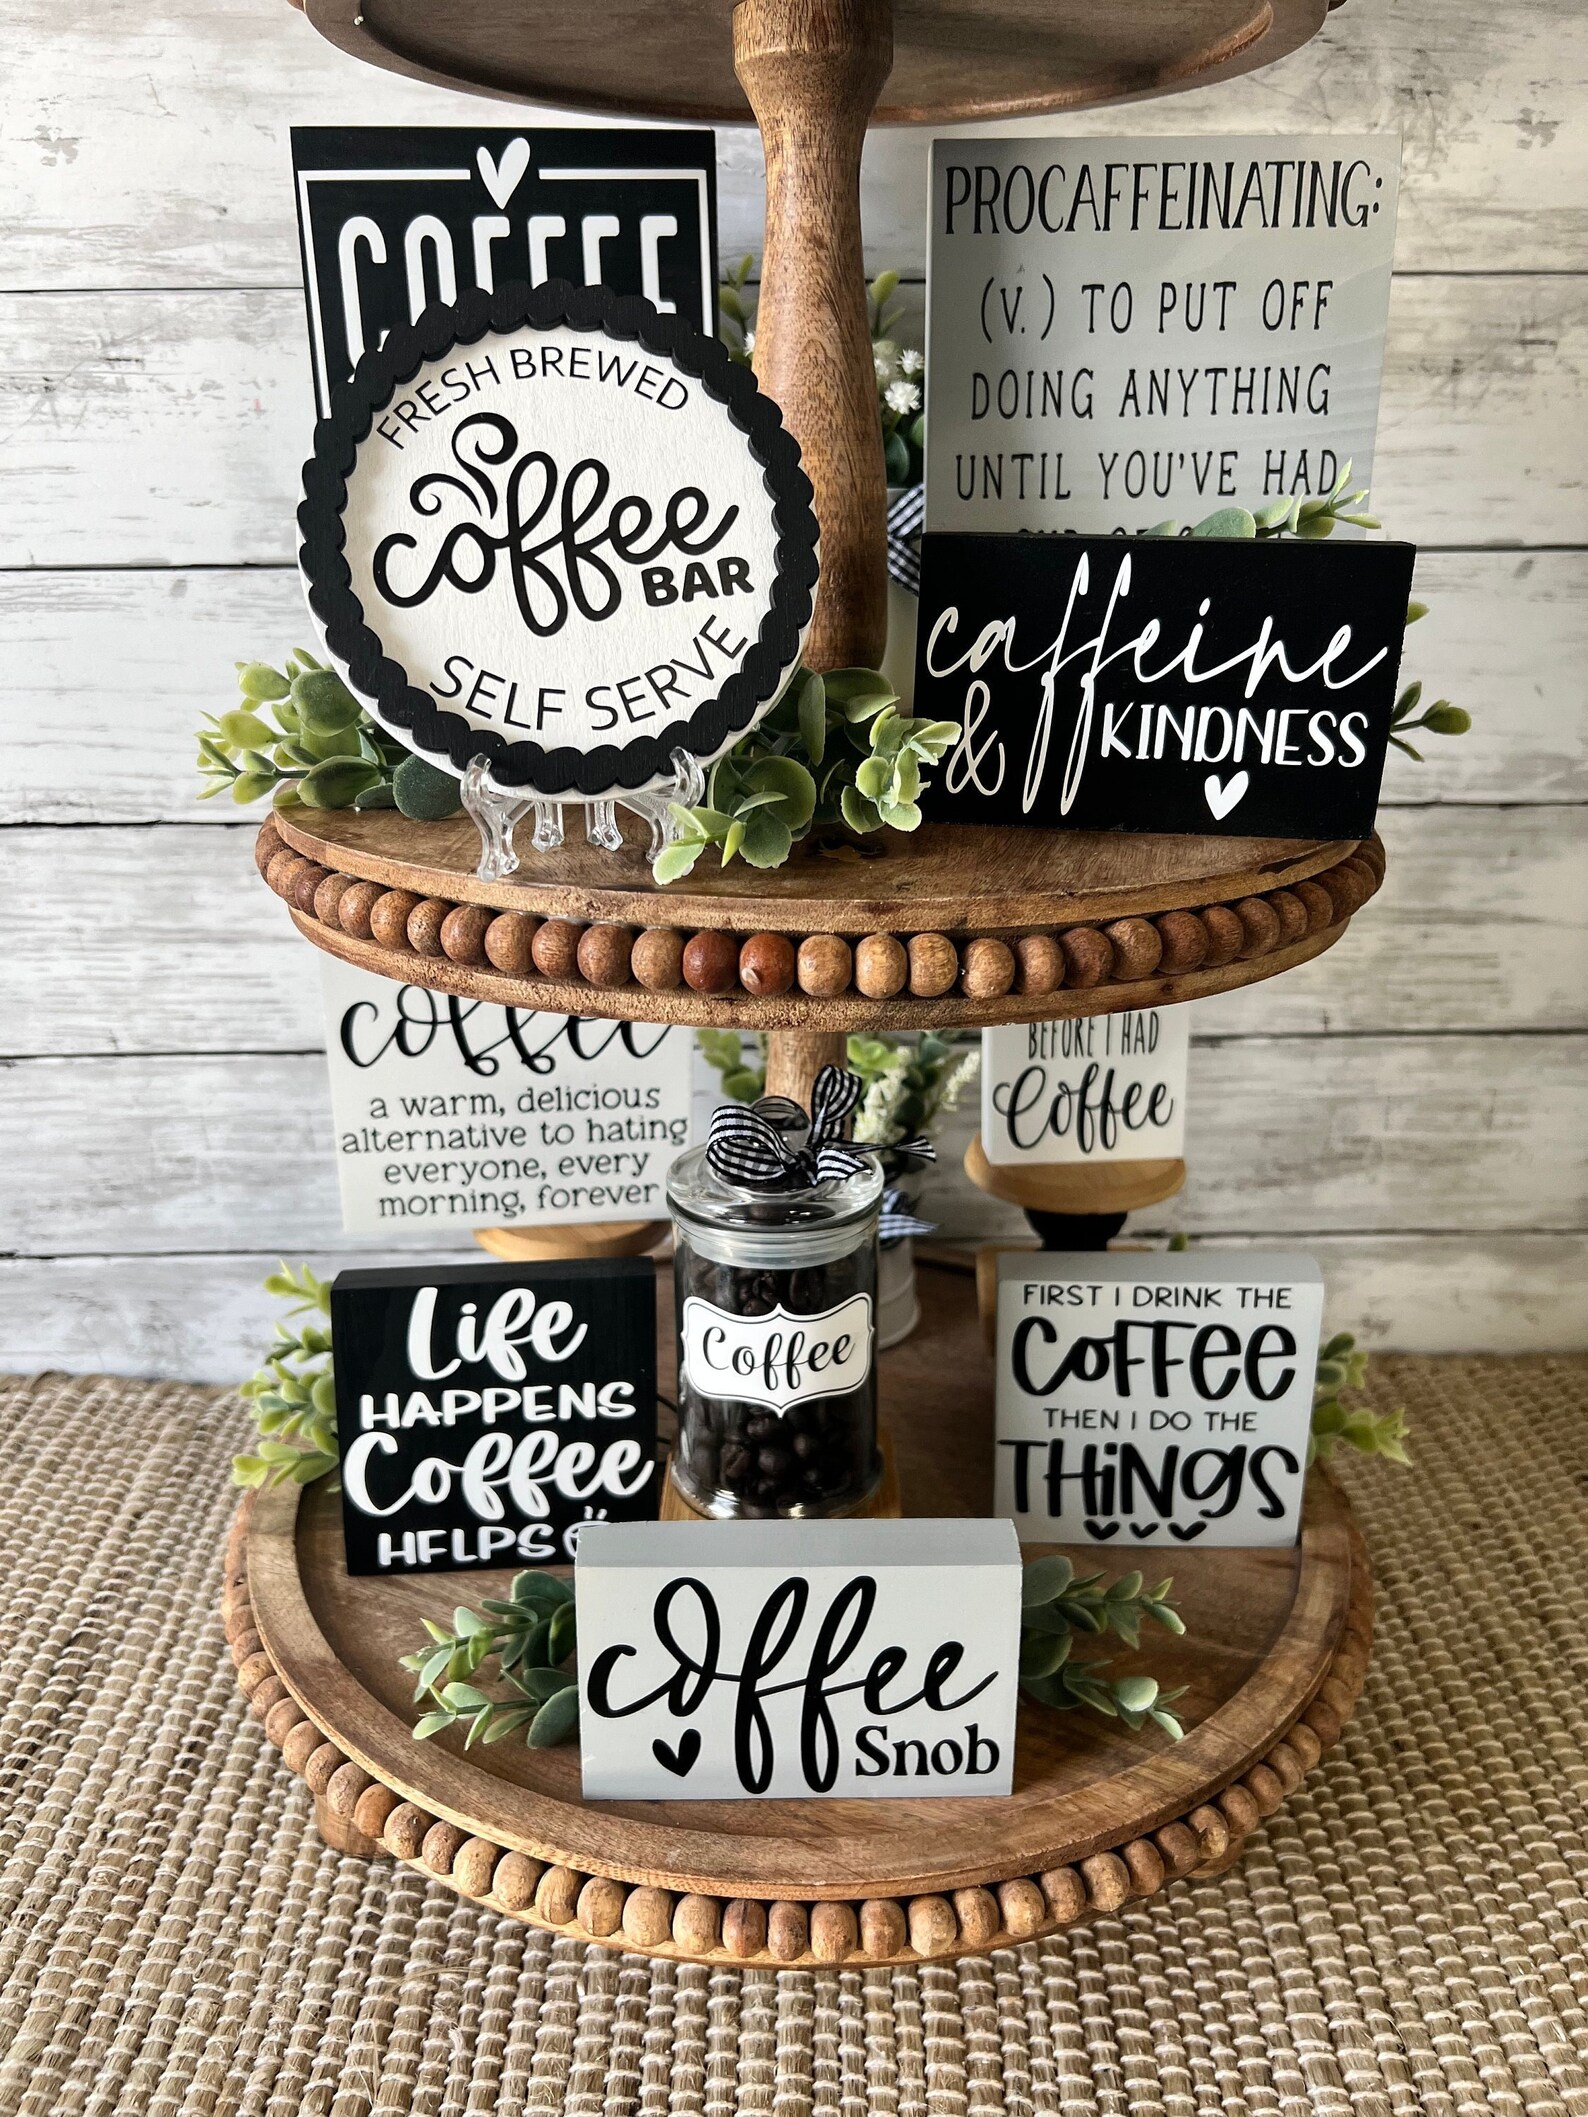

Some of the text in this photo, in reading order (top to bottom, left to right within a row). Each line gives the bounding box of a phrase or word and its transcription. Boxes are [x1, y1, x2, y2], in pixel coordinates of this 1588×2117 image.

[945, 160, 1383, 235] PROCAFFEINATING:
[1081, 281, 1133, 334] TO
[1159, 280, 1237, 333] PUT
[1262, 278, 1334, 332] OFF
[376, 346, 689, 450] FRESH BREWED
[971, 363, 1332, 421] DOING ANYTHING
[956, 449, 1337, 501] UNTIL YOU'VE HAD
[373, 450, 739, 638] coffee
[641, 556, 755, 607] BAR
[430, 614, 748, 731] SELF SERVE
[926, 551, 1389, 816] caffeine
[945, 680, 1369, 796] & KINDNESS
[1028, 1010, 1160, 1060] BEFORE I HAD
[370, 1083, 661, 1120] a warm, delicious
[993, 1062, 1174, 1154] Coffee
[342, 1115, 688, 1154] alternative to hating
[384, 1152, 651, 1187] everyone, every
[379, 1183, 661, 1218] morning, forever
[1023, 1284, 1293, 1310] FIRST I DRINK THE
[407, 1286, 589, 1382] Life
[702, 1326, 856, 1391] Coffee
[359, 1381, 637, 1430] HAPPENS
[1043, 1408, 1259, 1432] THEN I DO THE
[344, 1430, 655, 1521] Coffee
[586, 1575, 999, 1795] coffee
[855, 1723, 1000, 1778] Snob
